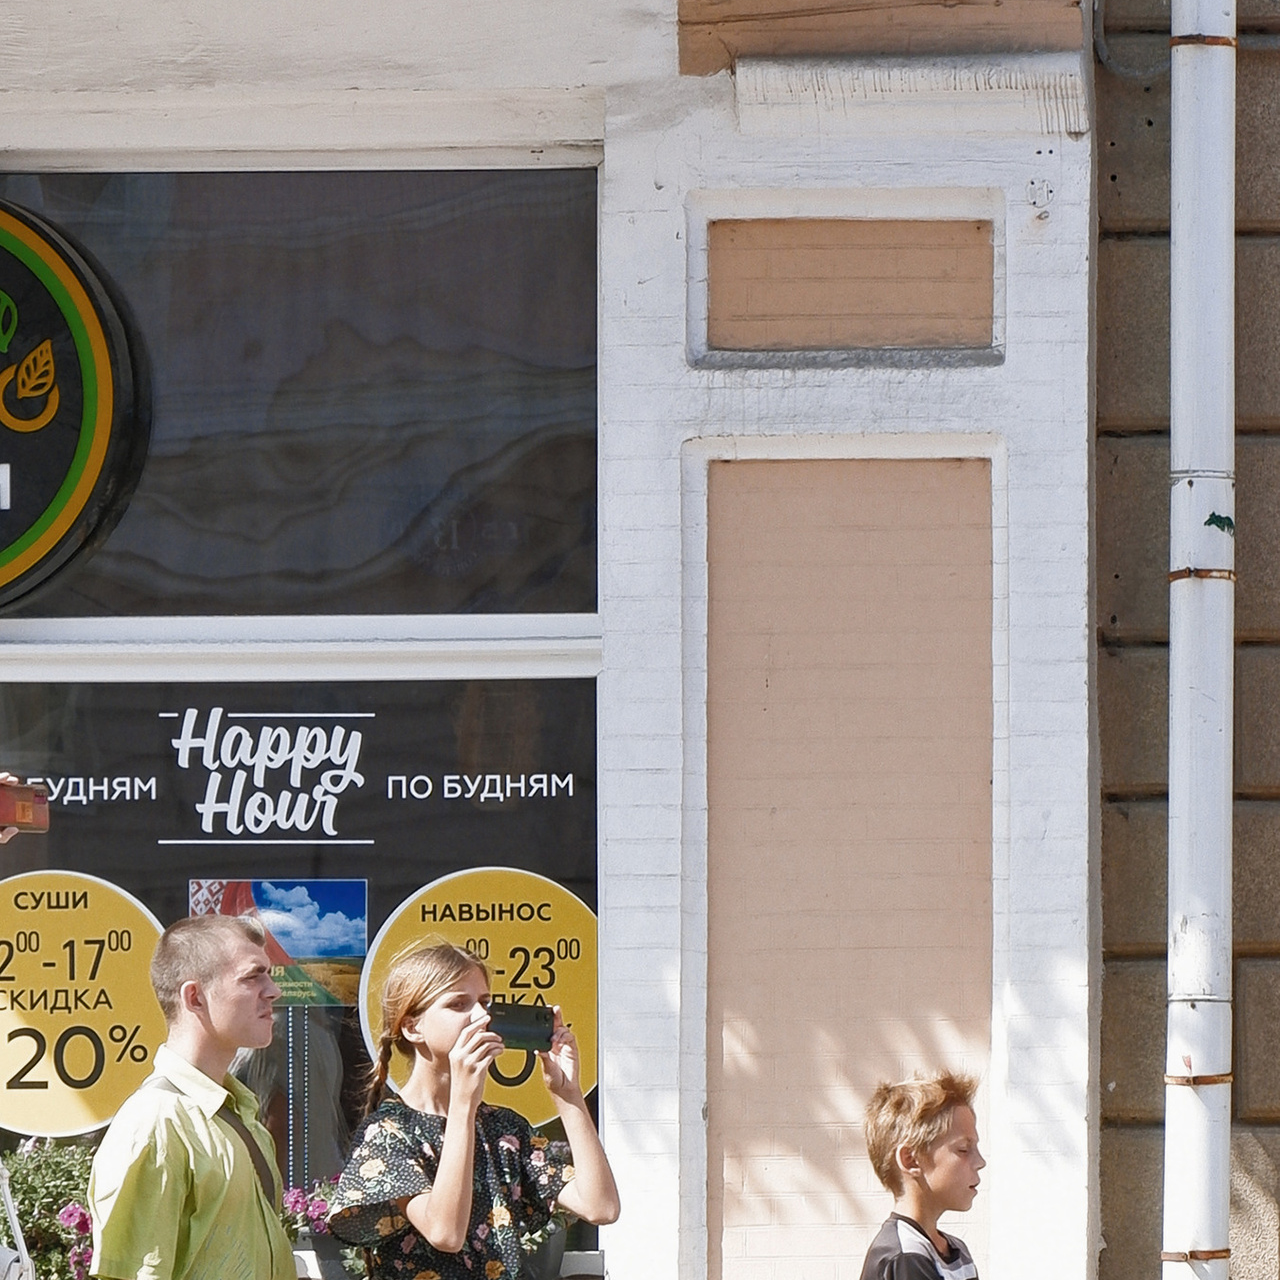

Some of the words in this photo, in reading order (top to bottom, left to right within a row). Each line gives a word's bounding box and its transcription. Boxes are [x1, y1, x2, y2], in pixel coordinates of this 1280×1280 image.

[171, 707, 365, 794] Happy
[195, 768, 339, 836] Hour
[387, 775, 433, 800] ПО
[443, 773, 574, 803] БУДНЯМ
[13, 891, 89, 911] СУШИ
[421, 903, 552, 923] НАВЫНОС
